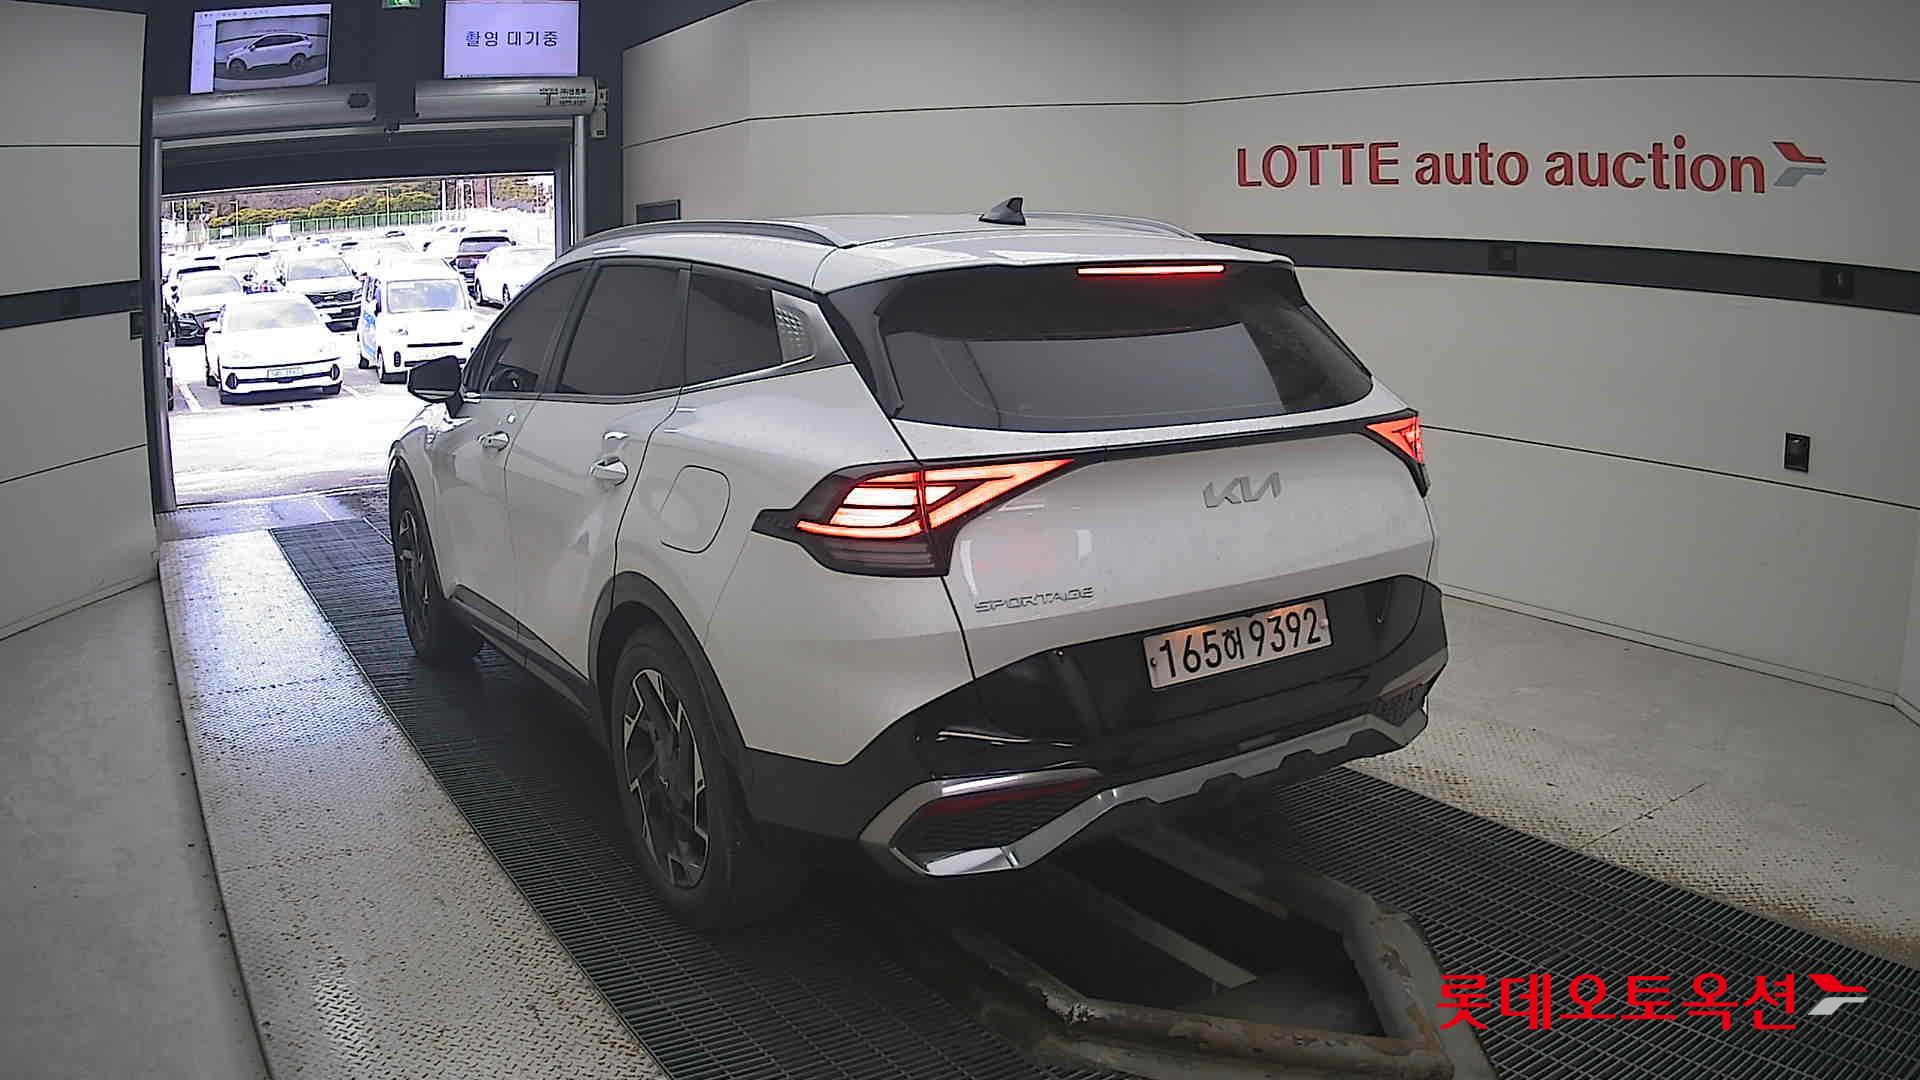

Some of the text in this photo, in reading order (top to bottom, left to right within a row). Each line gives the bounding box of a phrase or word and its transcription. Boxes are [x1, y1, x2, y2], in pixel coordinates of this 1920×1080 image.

[465, 31, 558, 47] 촬영 대기중
[1236, 134, 1765, 194] LOTTE auto auction
[1202, 471, 1281, 509] KIA
[974, 586, 1094, 613] SPORTAGE
